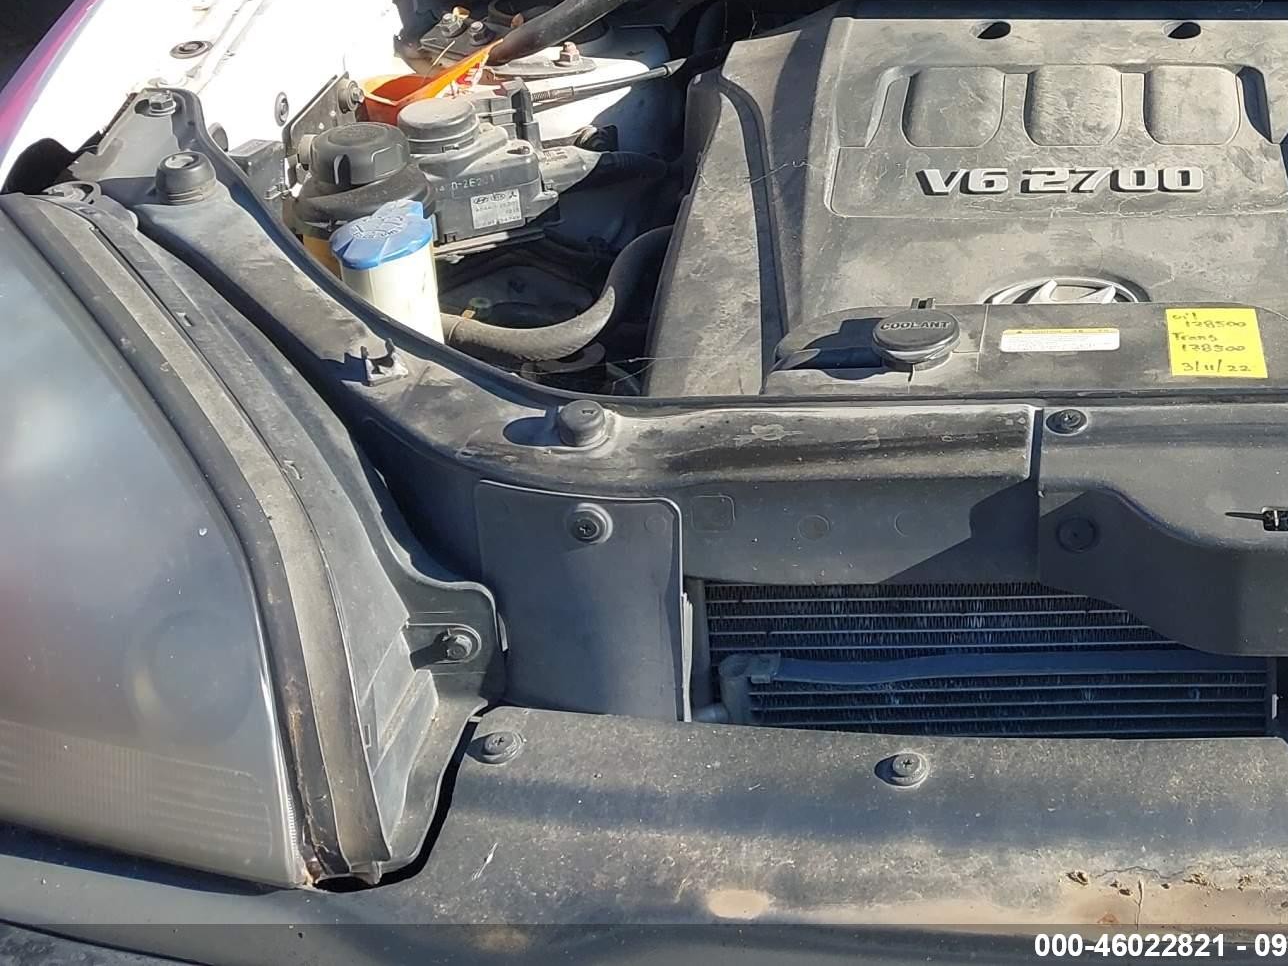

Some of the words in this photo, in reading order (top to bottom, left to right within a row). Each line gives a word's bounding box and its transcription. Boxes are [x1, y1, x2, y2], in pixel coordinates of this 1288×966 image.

[916, 168, 1008, 196] V6
[1020, 166, 1204, 194] 2700
[880, 320, 950, 331] COOLANT
